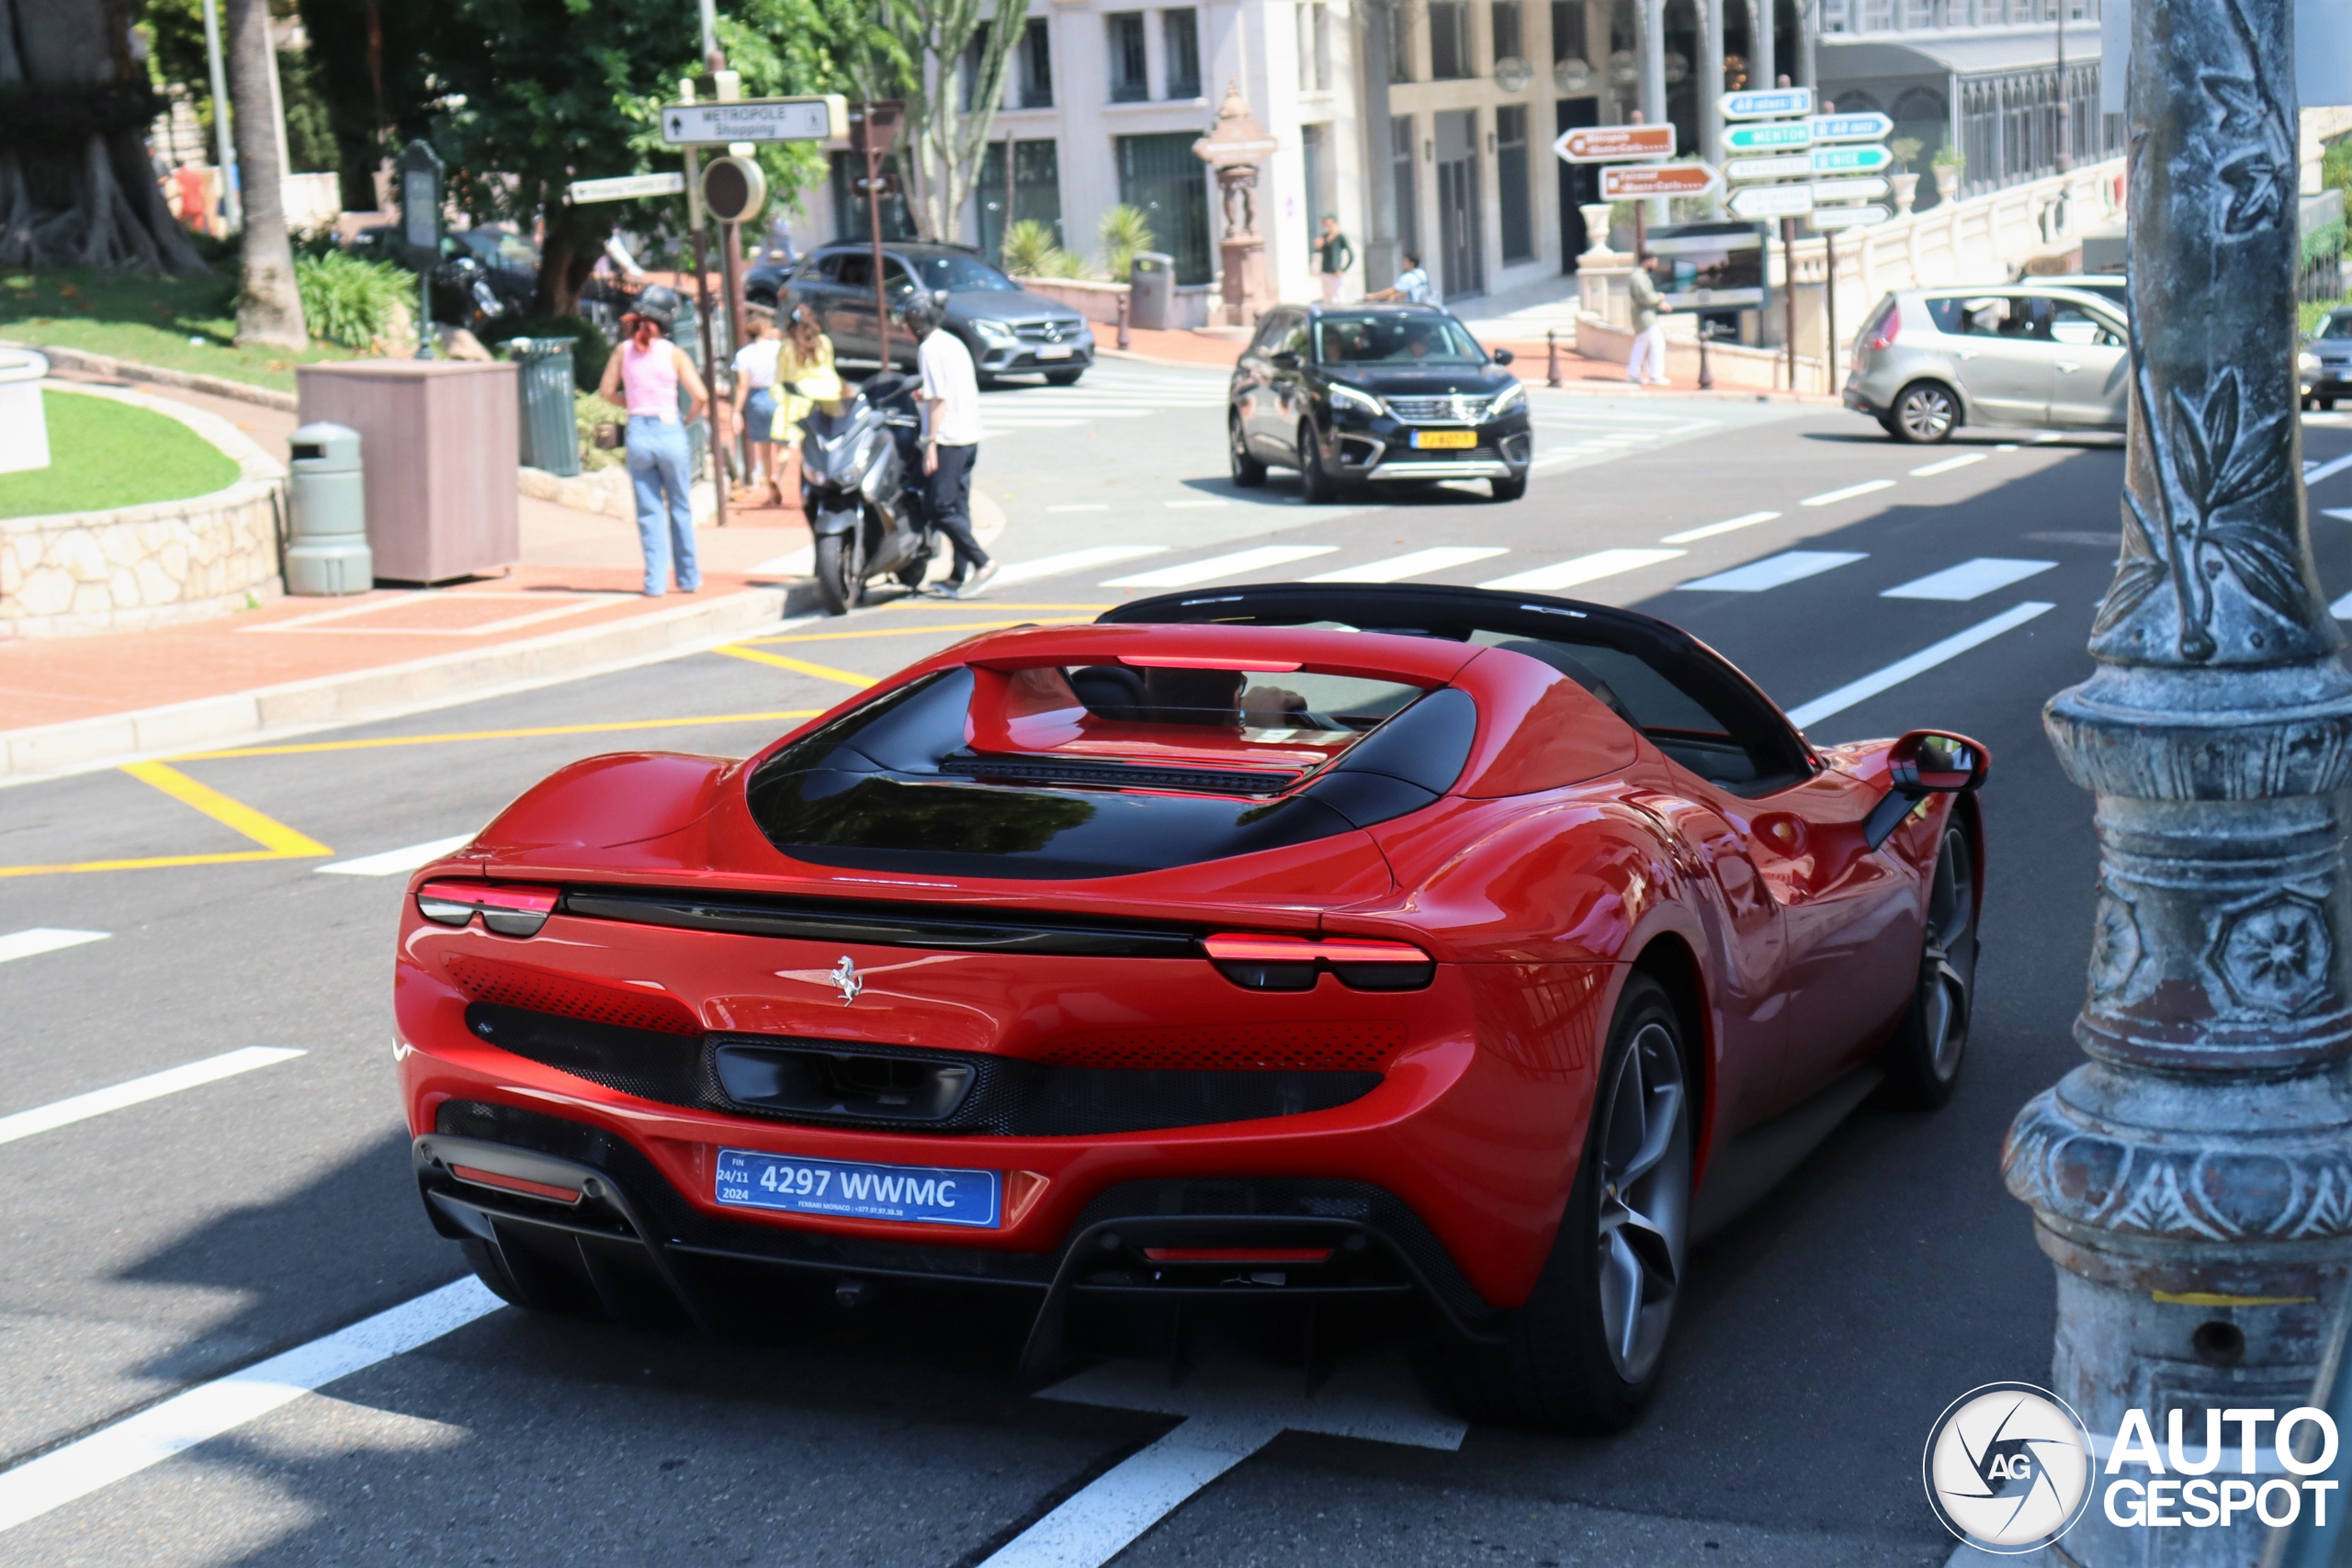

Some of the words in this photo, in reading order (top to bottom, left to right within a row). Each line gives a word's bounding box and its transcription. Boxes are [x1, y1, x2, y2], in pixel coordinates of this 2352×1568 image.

[703, 107, 786, 121] METROPOLE
[716, 123, 775, 139] Shopping
[1752, 127, 1806, 143] MENTON
[1833, 152, 1860, 164] NICE
[1620, 172, 1658, 182] Fairmont
[732, 1158, 744, 1167] FIN
[718, 1169, 749, 1184] 24/11
[760, 1166, 831, 1197] 4297
[840, 1171, 956, 1208] WWMC
[722, 1188, 749, 1201] 2024
[797, 1201, 822, 1209] FERRARI
[823, 1203, 851, 1212] MONACO
